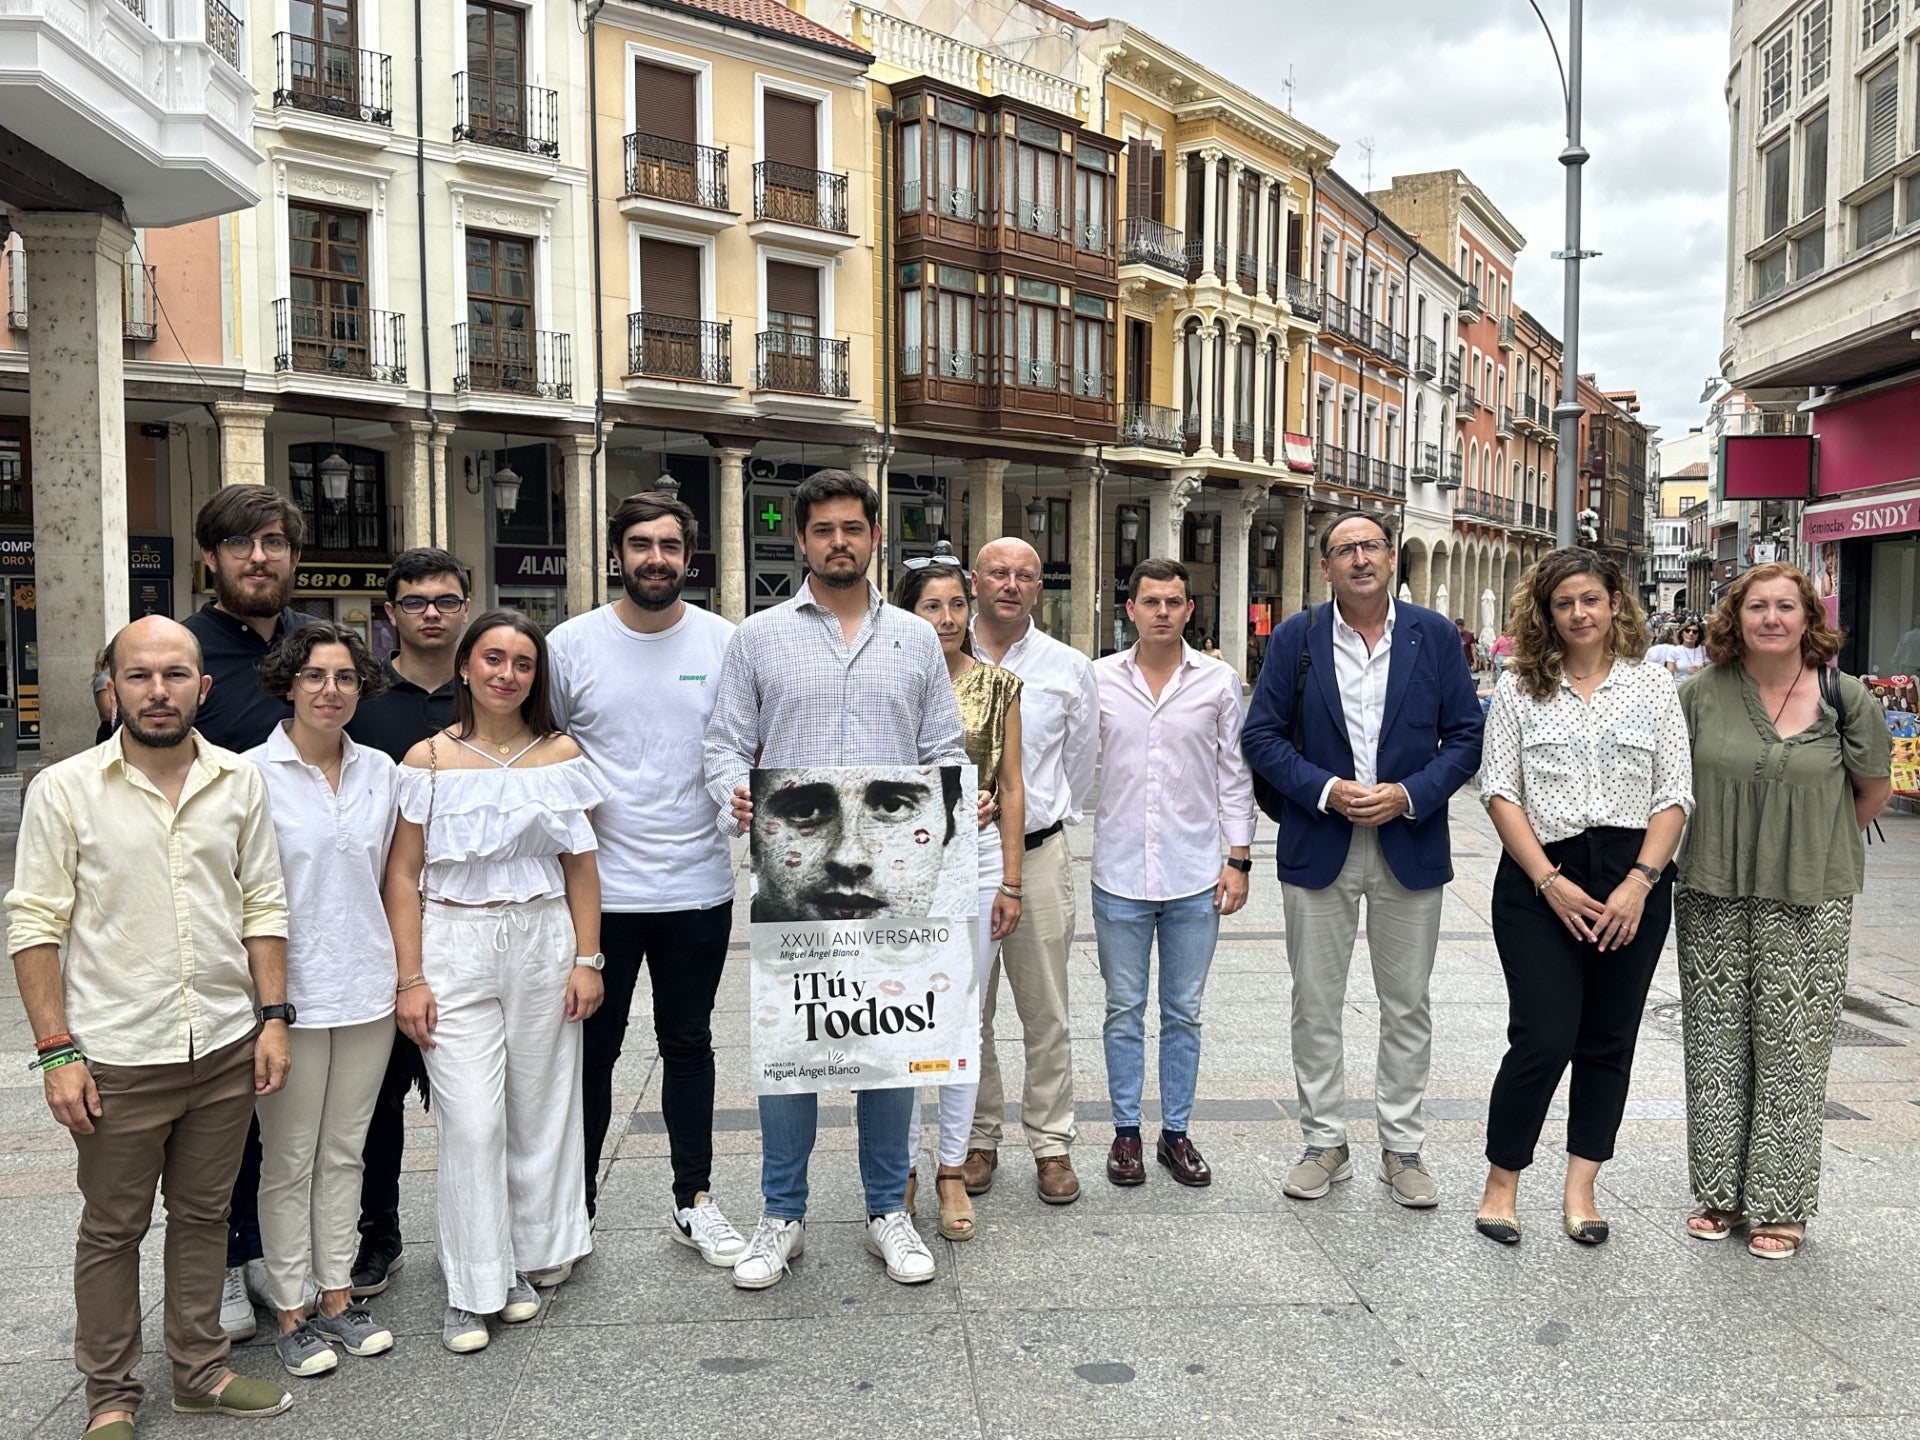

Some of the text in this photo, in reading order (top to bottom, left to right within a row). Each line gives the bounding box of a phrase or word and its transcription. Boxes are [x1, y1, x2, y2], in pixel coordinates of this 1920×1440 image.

[1851, 503, 1912, 531] SINDY
[0, 541, 35, 552] OMP
[3, 556, 25, 565] ORO
[131, 554, 161, 563] ORO
[297, 573, 386, 587] sero Re
[780, 928, 949, 948] XXVII ANIVERSARIO
[780, 948, 860, 961] Miguel Ángel Blanco
[793, 971, 866, 1002] ¡Tú y
[795, 990, 936, 1042] Todos!
[763, 1064, 860, 1081] Miguel Ángel Blanco
